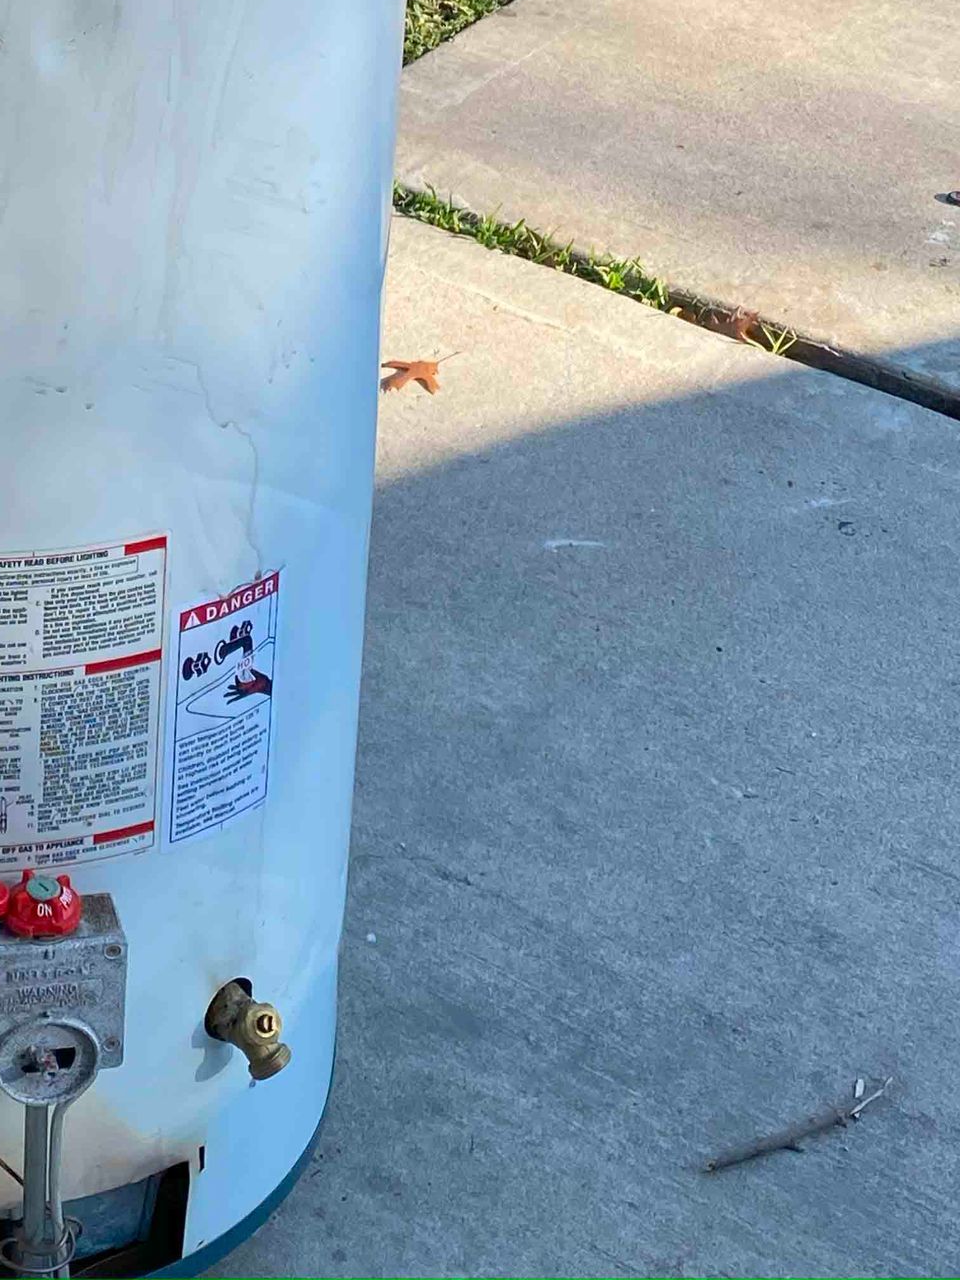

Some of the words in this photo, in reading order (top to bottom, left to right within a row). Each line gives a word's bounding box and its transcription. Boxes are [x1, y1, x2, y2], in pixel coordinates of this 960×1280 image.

[24, 558, 44, 567] READ
[46, 554, 74, 566] BEFORE
[77, 551, 108, 563] LIGHTING
[206, 580, 274, 620] DANGER
[22, 670, 74, 682] INSTRUCTIONS
[18, 845, 33, 853] GAS
[35, 844, 44, 852] TO
[46, 840, 84, 851] APPLIANCE
[37, 903, 52, 916] ON
